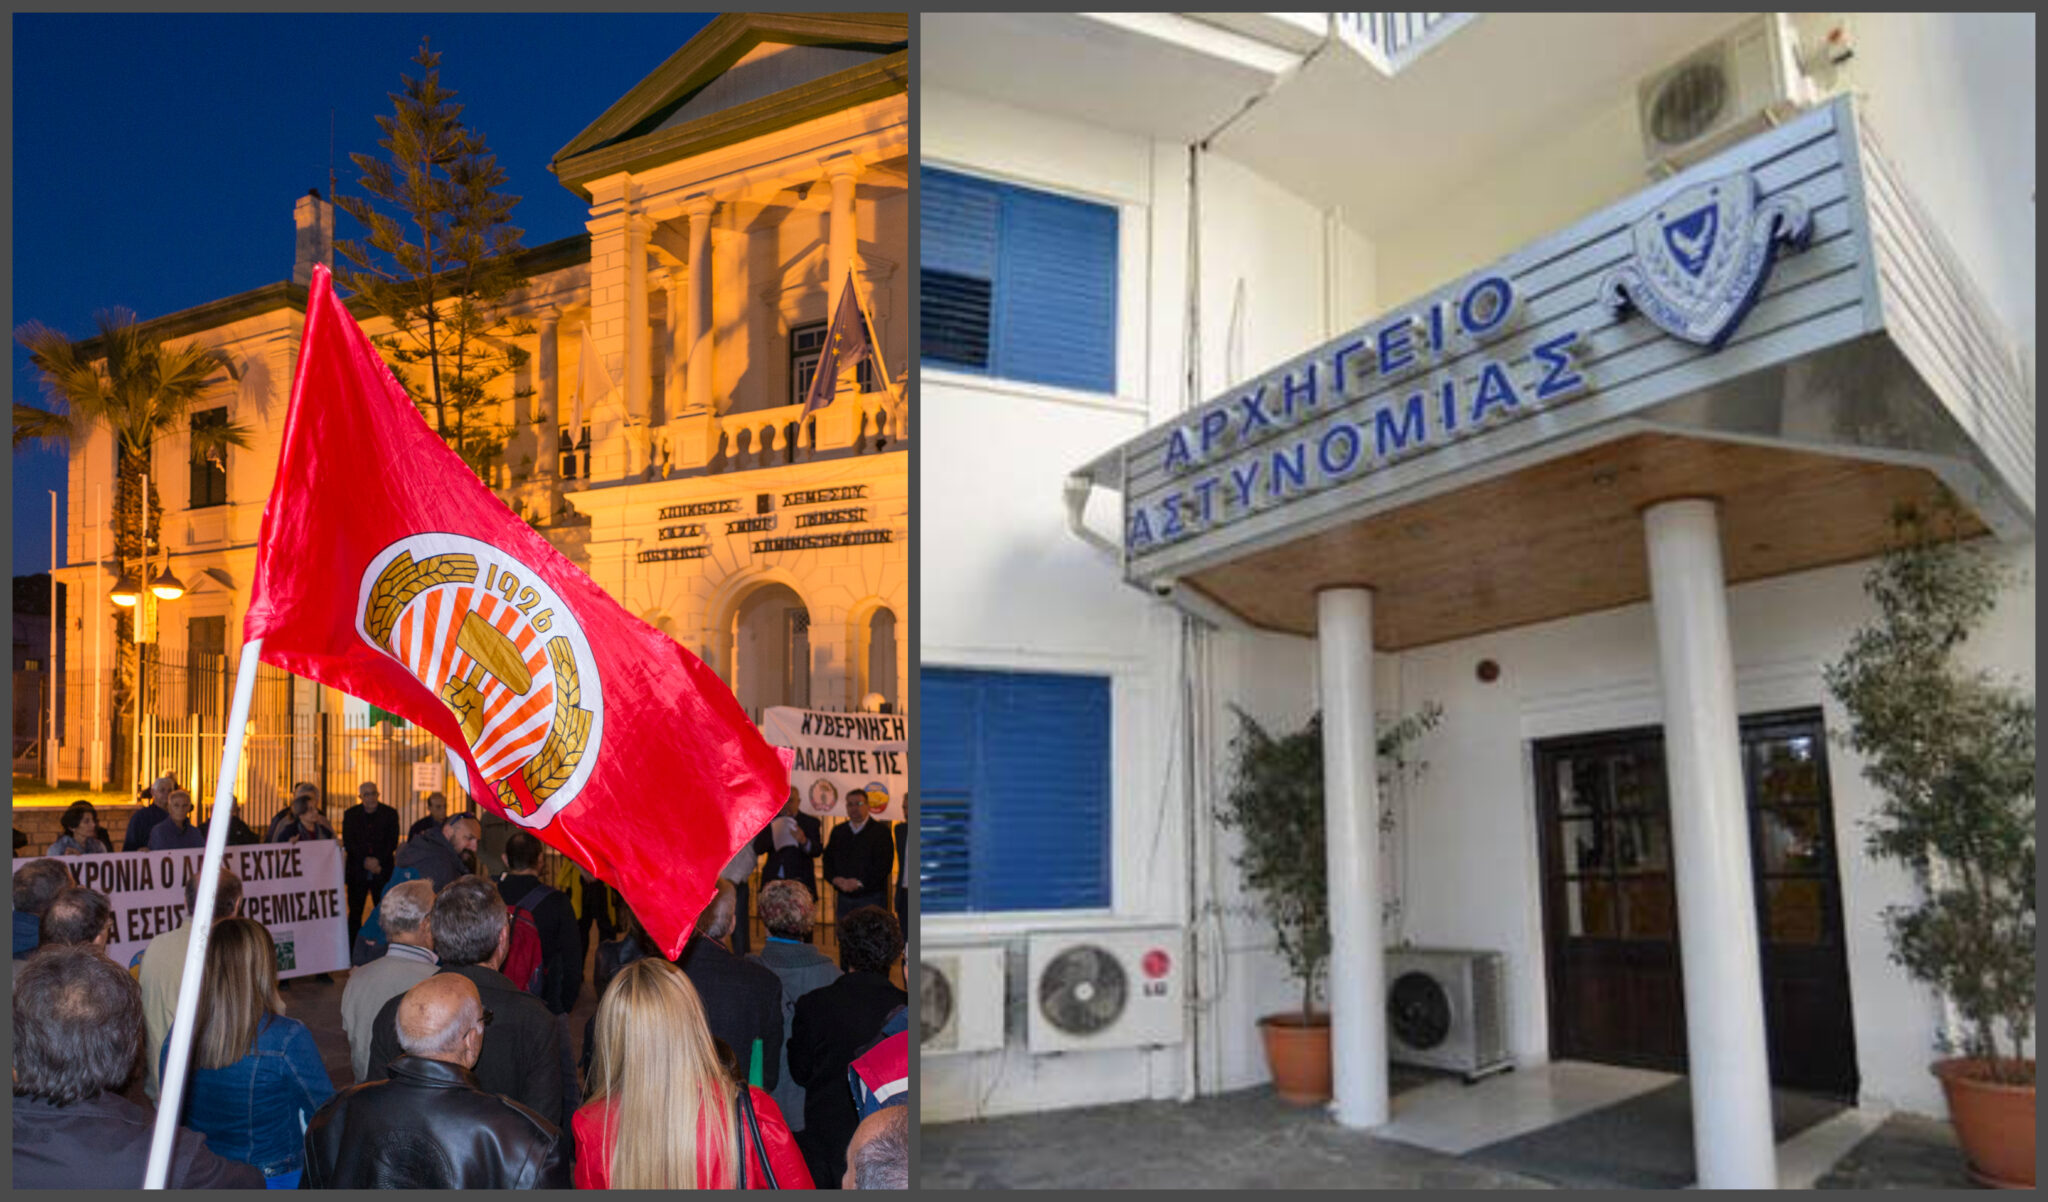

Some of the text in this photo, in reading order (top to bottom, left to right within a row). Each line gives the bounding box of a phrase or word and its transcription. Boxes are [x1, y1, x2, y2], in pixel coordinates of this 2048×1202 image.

[1163, 276, 1514, 472] ΑΡΧΗΓΕΙΟ
[1129, 331, 1582, 548] ΑΣΤΥΝΟΜΙΑΣ
[752, 529, 893, 553] ADMINISTRATION
[485, 563, 556, 634] 1926
[793, 746, 869, 774] ΑΛΑΒΕΤΕ
[872, 750, 902, 775] ΤΙΣ
[240, 848, 303, 882] ΕΧΤΙΖΕ
[127, 904, 186, 942] ΕΣΕΙΣ
[1143, 981, 1168, 997] LG
